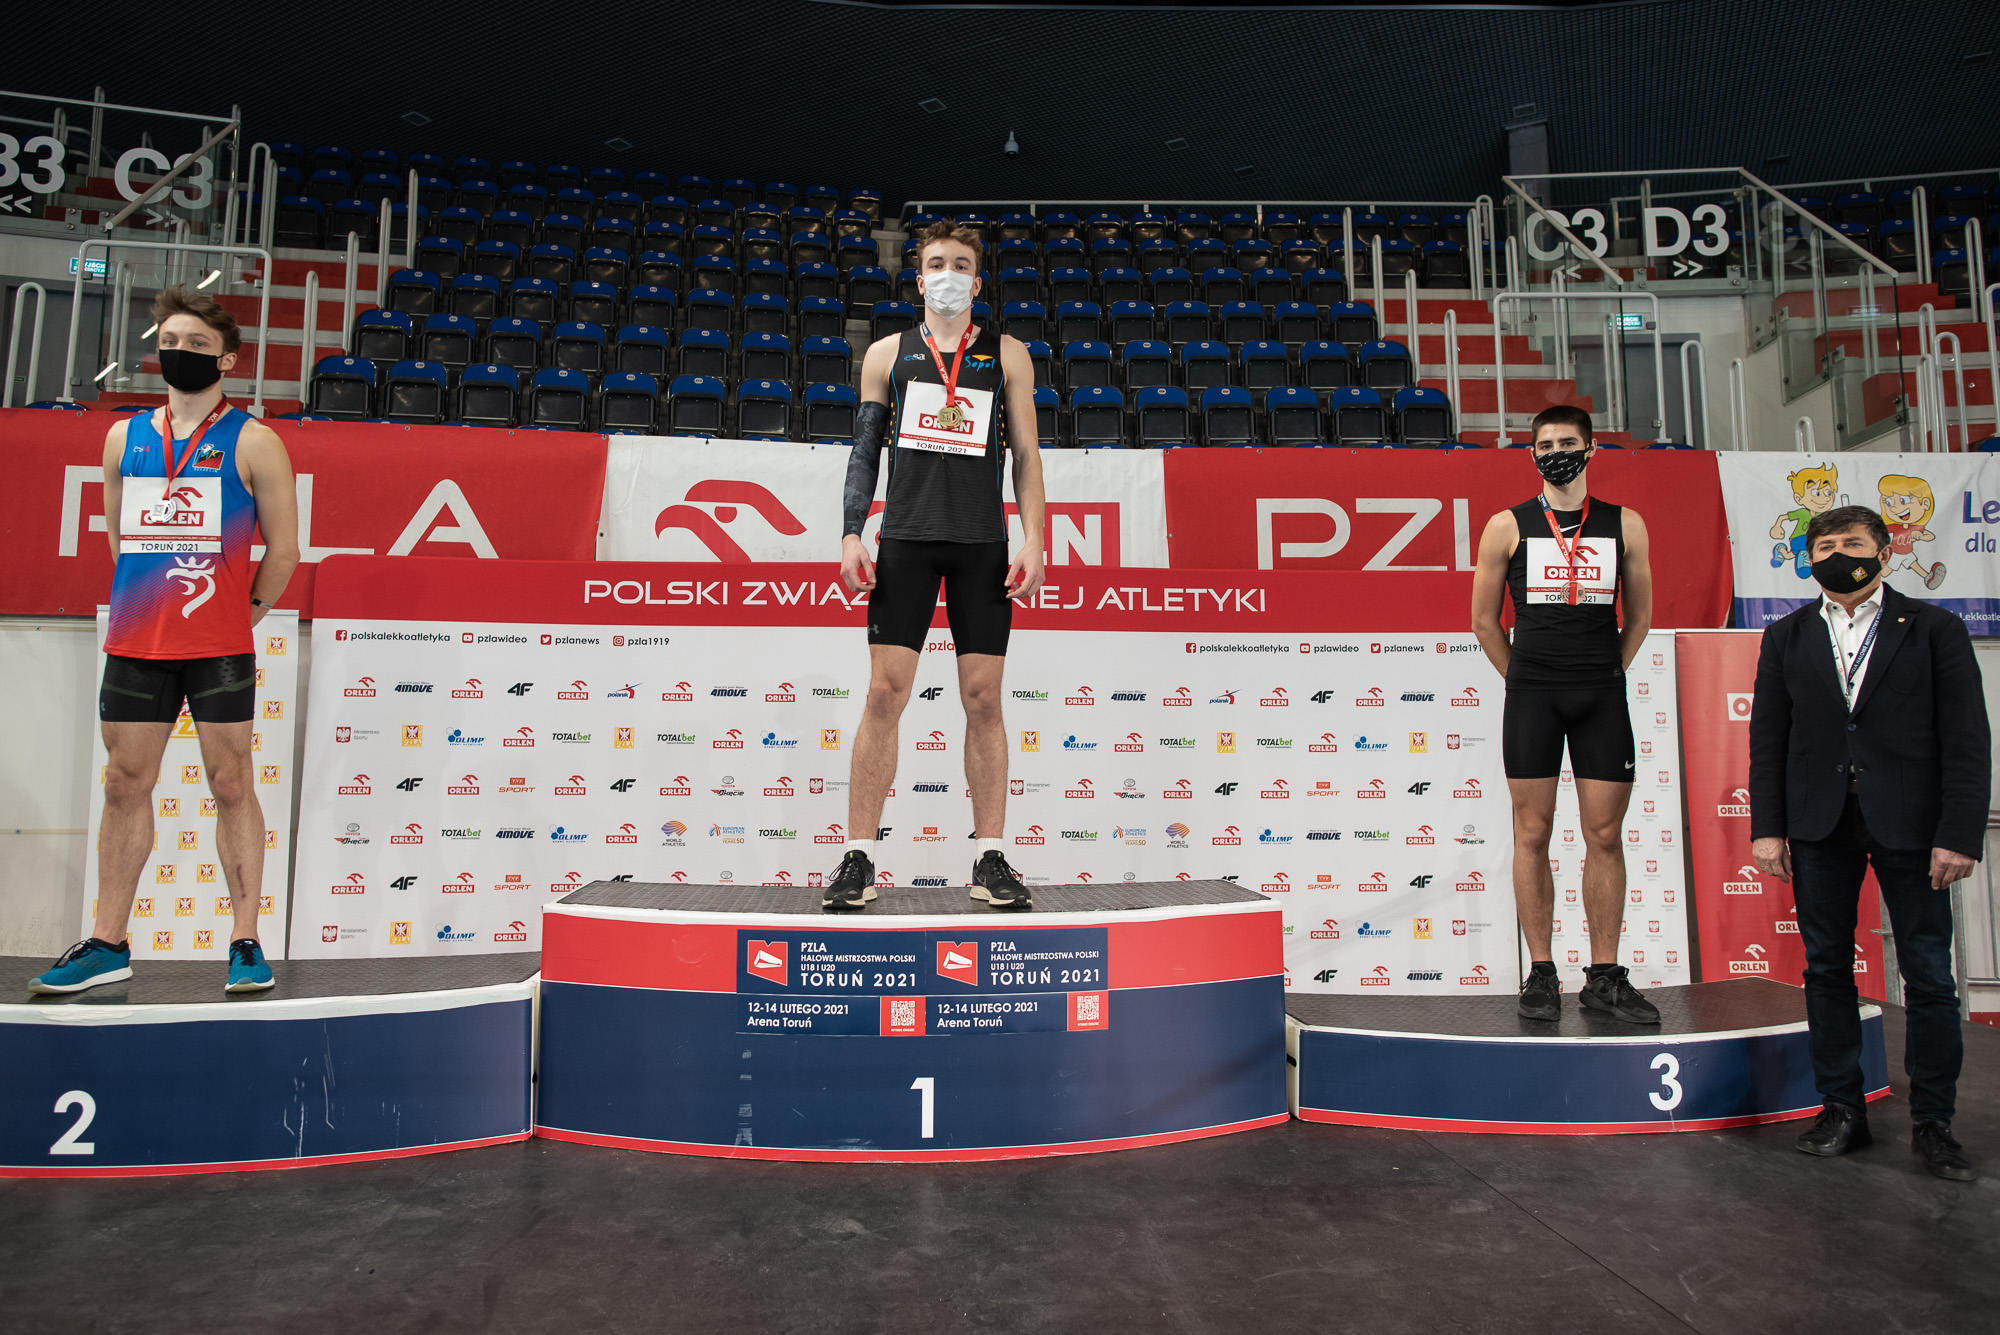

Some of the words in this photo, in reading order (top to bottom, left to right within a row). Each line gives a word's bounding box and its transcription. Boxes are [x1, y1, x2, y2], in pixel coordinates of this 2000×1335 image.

[114, 147, 214, 210] C3
[1523, 208, 1609, 262] C3
[1644, 203, 1730, 257] D3
[964, 356, 996, 372] Sopot
[916, 442, 945, 450] TORUŃ
[1256, 498, 1478, 571] PZL
[141, 541, 173, 551] TORUŃ
[176, 543, 198, 551] 2021
[1965, 532, 1996, 553] dla
[584, 580, 728, 606] POLSKI
[1095, 586, 1266, 612] ATLETYKI
[350, 631, 450, 642] polskalekkoatletyka
[477, 634, 528, 644] pzlawideo
[555, 635, 600, 646] pzlanews
[628, 636, 670, 647] pzla1919
[1200, 643, 1290, 654] polskalekkoatletyka
[1314, 644, 1359, 654] pzlawideo
[1384, 644, 1424, 654] pzlanews
[1450, 644, 1482, 654] pzla191
[395, 685, 434, 693] 4MOVE
[508, 683, 533, 696] 4F
[710, 688, 748, 697] 4MOVE
[812, 688, 849, 696] TOTALbet
[1311, 690, 1334, 703] 4F
[552, 732, 591, 740] TOTALbet
[657, 733, 696, 742] TOTALbet
[396, 778, 423, 791] 4F
[610, 779, 636, 792] 4F
[912, 784, 948, 792] 4MOVE
[1215, 783, 1239, 795] 4F
[1408, 782, 1431, 795] 4F
[441, 828, 482, 837] TOTALbet
[496, 830, 535, 839] 4MOVE
[1061, 830, 1098, 838] TOTALbet
[1306, 832, 1342, 840] 4MOVE
[390, 876, 418, 890] 4F
[1410, 875, 1433, 888] 4F
[1726, 884, 1760, 892] ORLEN
[801, 942, 827, 952] PZLA
[991, 941, 1016, 952] PZLA
[801, 954, 833, 962] HALOWE
[835, 954, 888, 962] MISTRZOSTWA
[991, 954, 1022, 962] HALOWE
[1024, 952, 1074, 960] MISTRZOSTWA
[1076, 950, 1099, 958] POLSKI
[1732, 963, 1766, 971] ORLEN
[801, 970, 863, 987] TORUŃ
[873, 974, 916, 987] 2021
[991, 968, 1051, 986] TORUŃ
[1061, 969, 1100, 983] 2021
[1314, 970, 1337, 983] 4F
[1407, 972, 1442, 980] 4MOVE
[748, 1003, 778, 1013] 12-14
[780, 1003, 821, 1014] LUTEGO
[823, 1004, 849, 1014] 2021
[937, 1003, 968, 1013] 12-14
[970, 1003, 1011, 1013] LUTEGO
[1013, 1002, 1038, 1012] 2021
[747, 1016, 780, 1027] Arena
[782, 1016, 812, 1028] Toruń
[937, 1017, 969, 1028] Arena
[972, 1015, 1003, 1027] Toruń
[1649, 1053, 1682, 1110] 3
[910, 1077, 934, 1138] 1
[50, 1090, 96, 1154] 2
